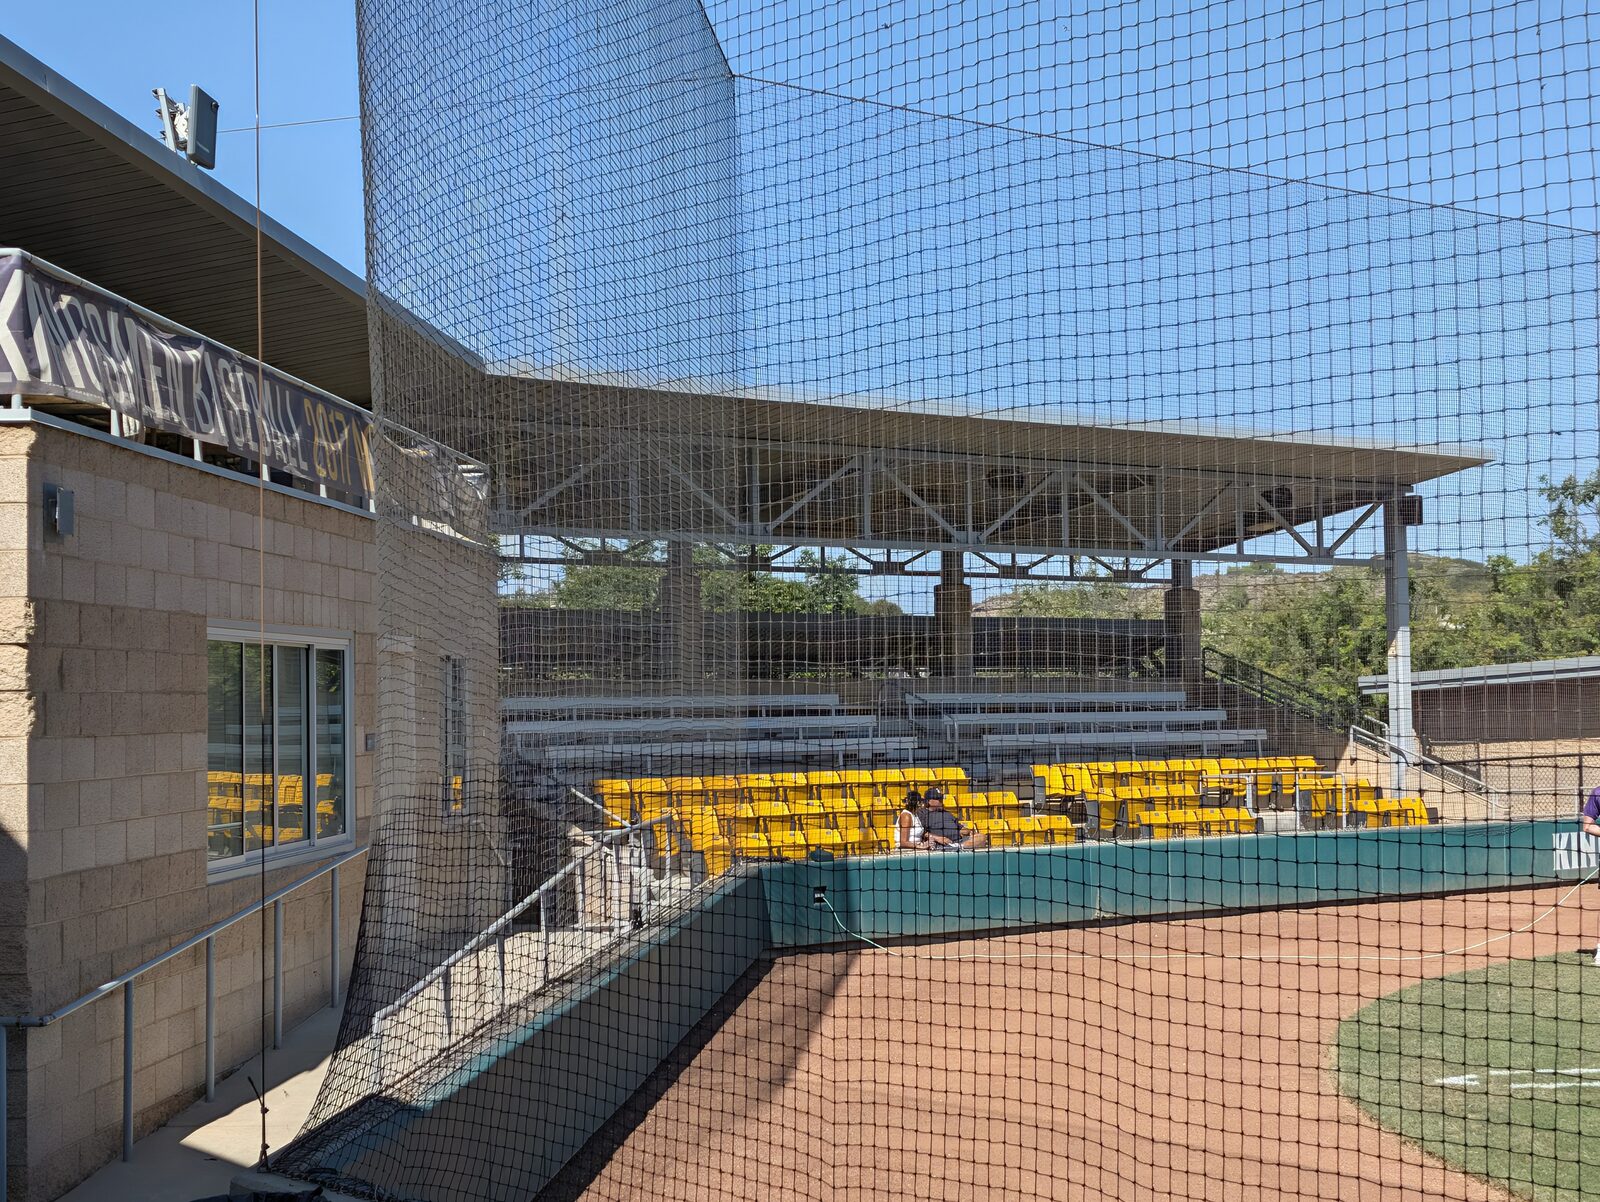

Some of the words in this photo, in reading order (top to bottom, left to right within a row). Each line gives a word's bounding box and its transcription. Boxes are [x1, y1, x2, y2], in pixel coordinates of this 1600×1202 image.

[186, 349, 309, 471] BASEBALL
[304, 398, 351, 486] 2017
[1552, 831, 1600, 871] KIN
